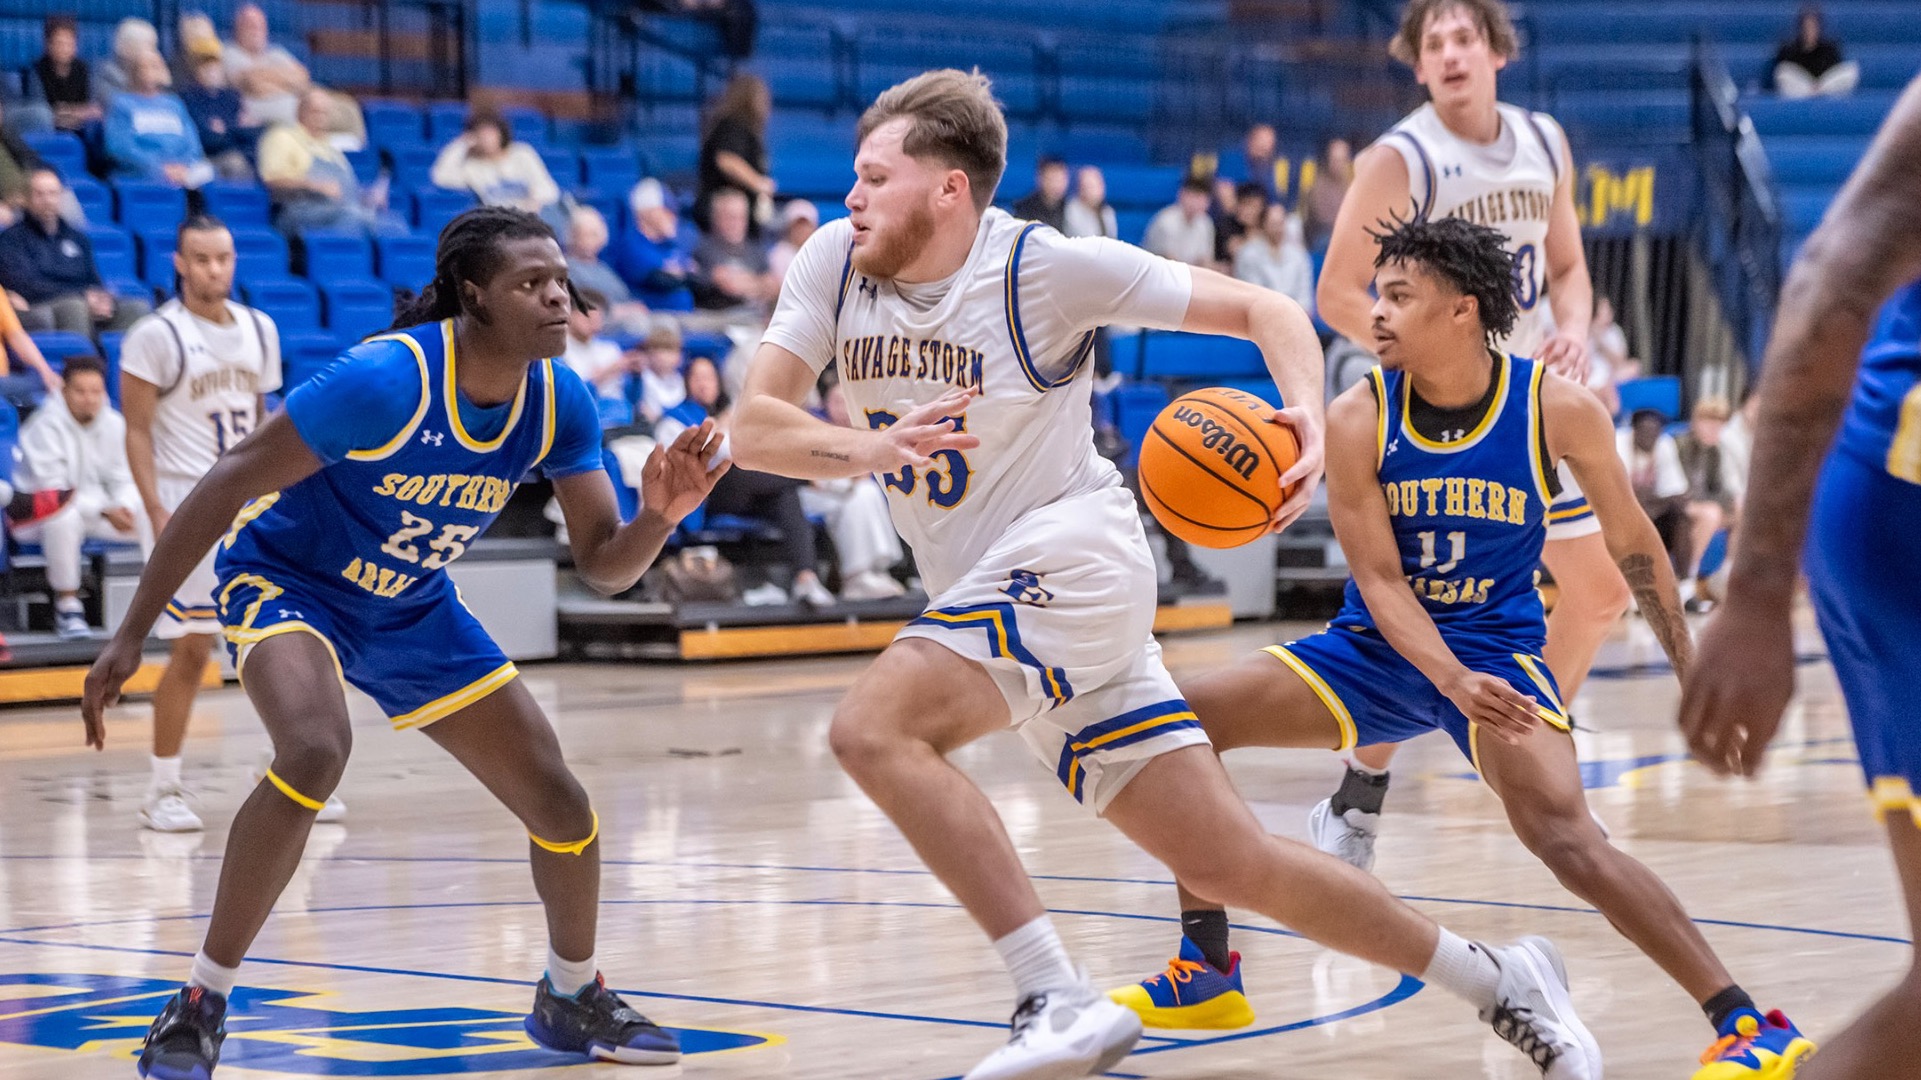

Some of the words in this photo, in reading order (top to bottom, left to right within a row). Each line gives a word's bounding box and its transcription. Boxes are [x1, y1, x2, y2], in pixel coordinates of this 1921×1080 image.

[844, 335, 911, 382] SAVAGE
[917, 339, 984, 395] STORM
[1172, 404, 1261, 482] Wilson
[373, 473, 520, 514] SOUTHER
[1382, 477, 1528, 526] OUTHERN
[381, 510, 480, 570] 25
[1417, 531, 1466, 574] 11
